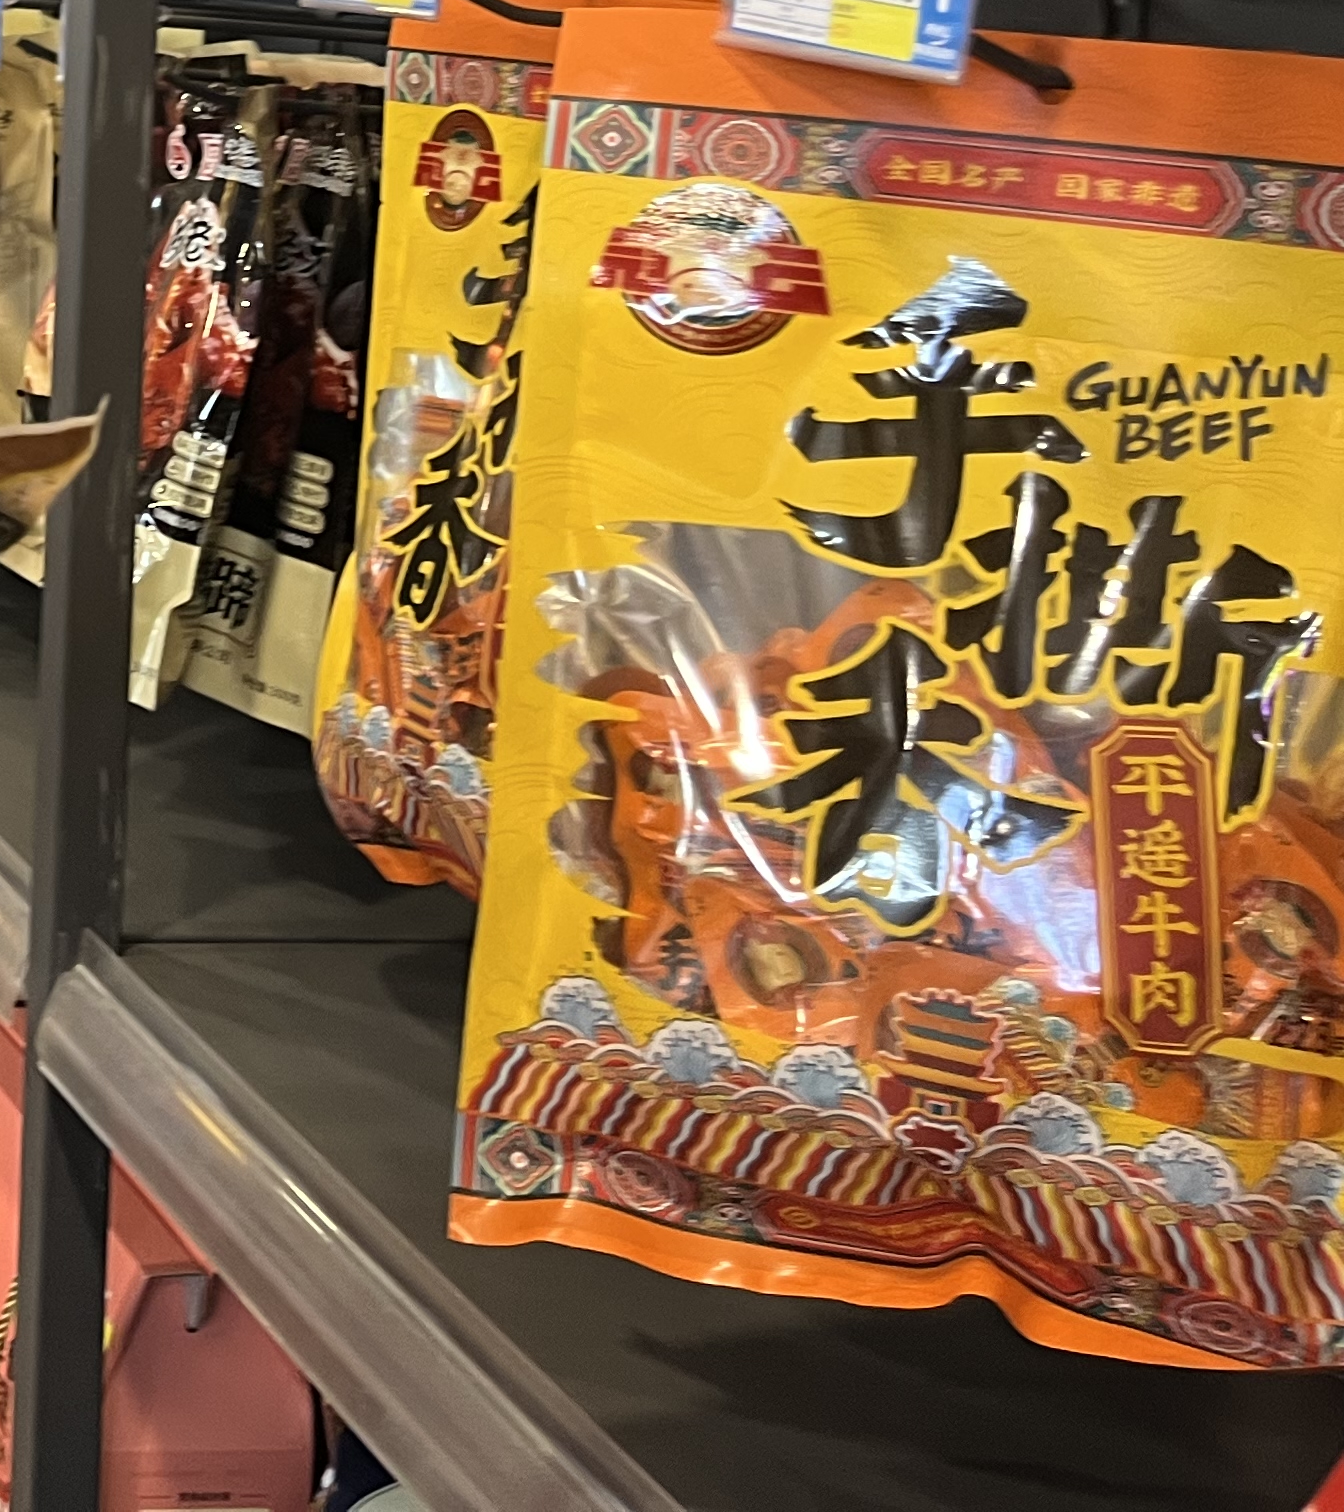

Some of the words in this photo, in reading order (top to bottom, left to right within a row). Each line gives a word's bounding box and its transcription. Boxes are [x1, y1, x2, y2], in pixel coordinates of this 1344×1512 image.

[882, 154, 1025, 189] 全国名产
[1065, 354, 1330, 413] GUANYUN
[1115, 407, 1274, 464] BEEF
[1113, 753, 1200, 1028] 平遥牛肉
